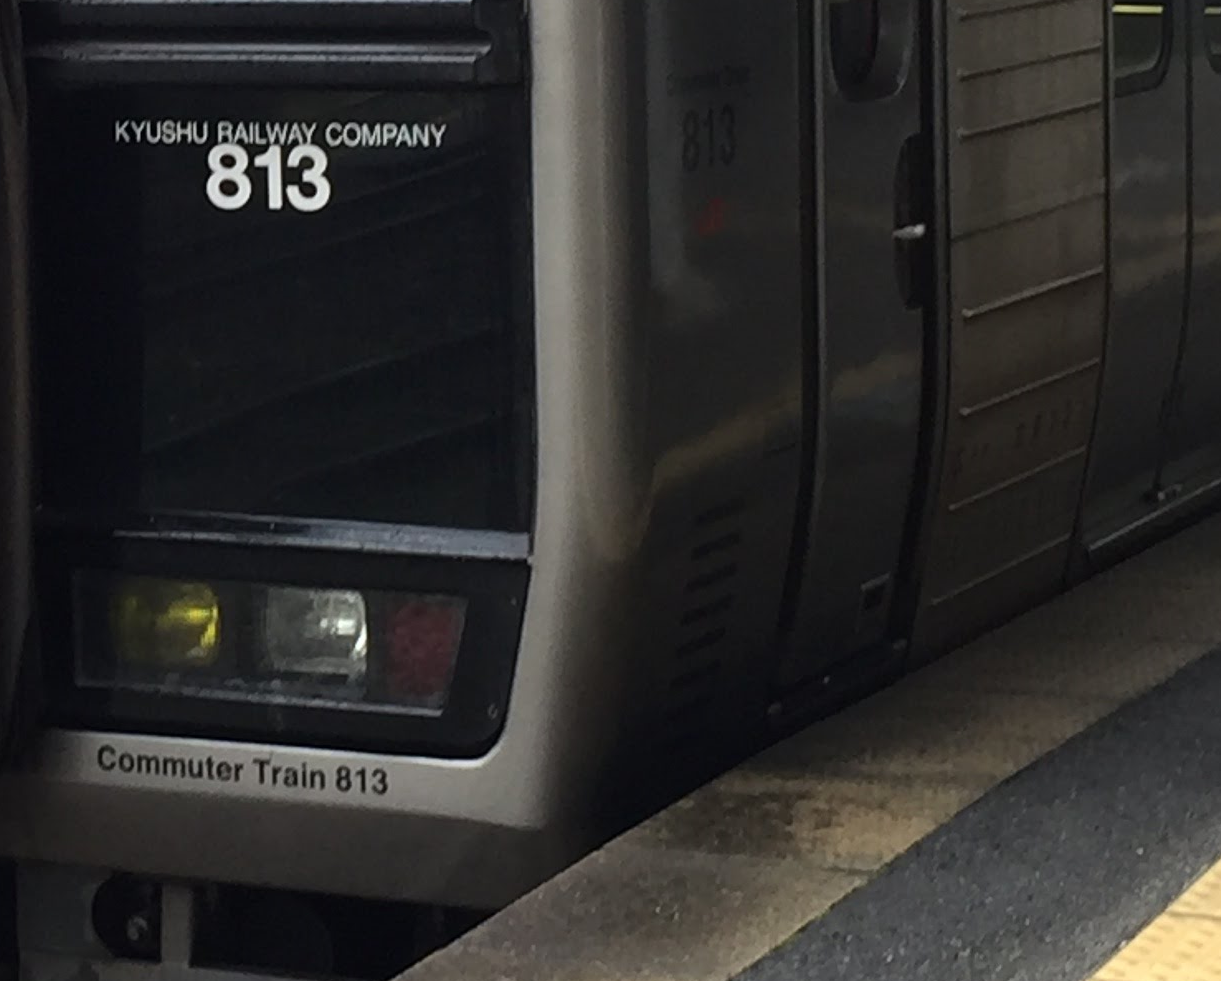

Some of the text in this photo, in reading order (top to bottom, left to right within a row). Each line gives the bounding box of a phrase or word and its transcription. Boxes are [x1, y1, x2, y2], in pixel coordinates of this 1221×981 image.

[114, 120, 447, 148] KYUSHU RAILWAY COMPANY
[206, 143, 331, 212] 813
[97, 743, 389, 796] Commuter Train 813
